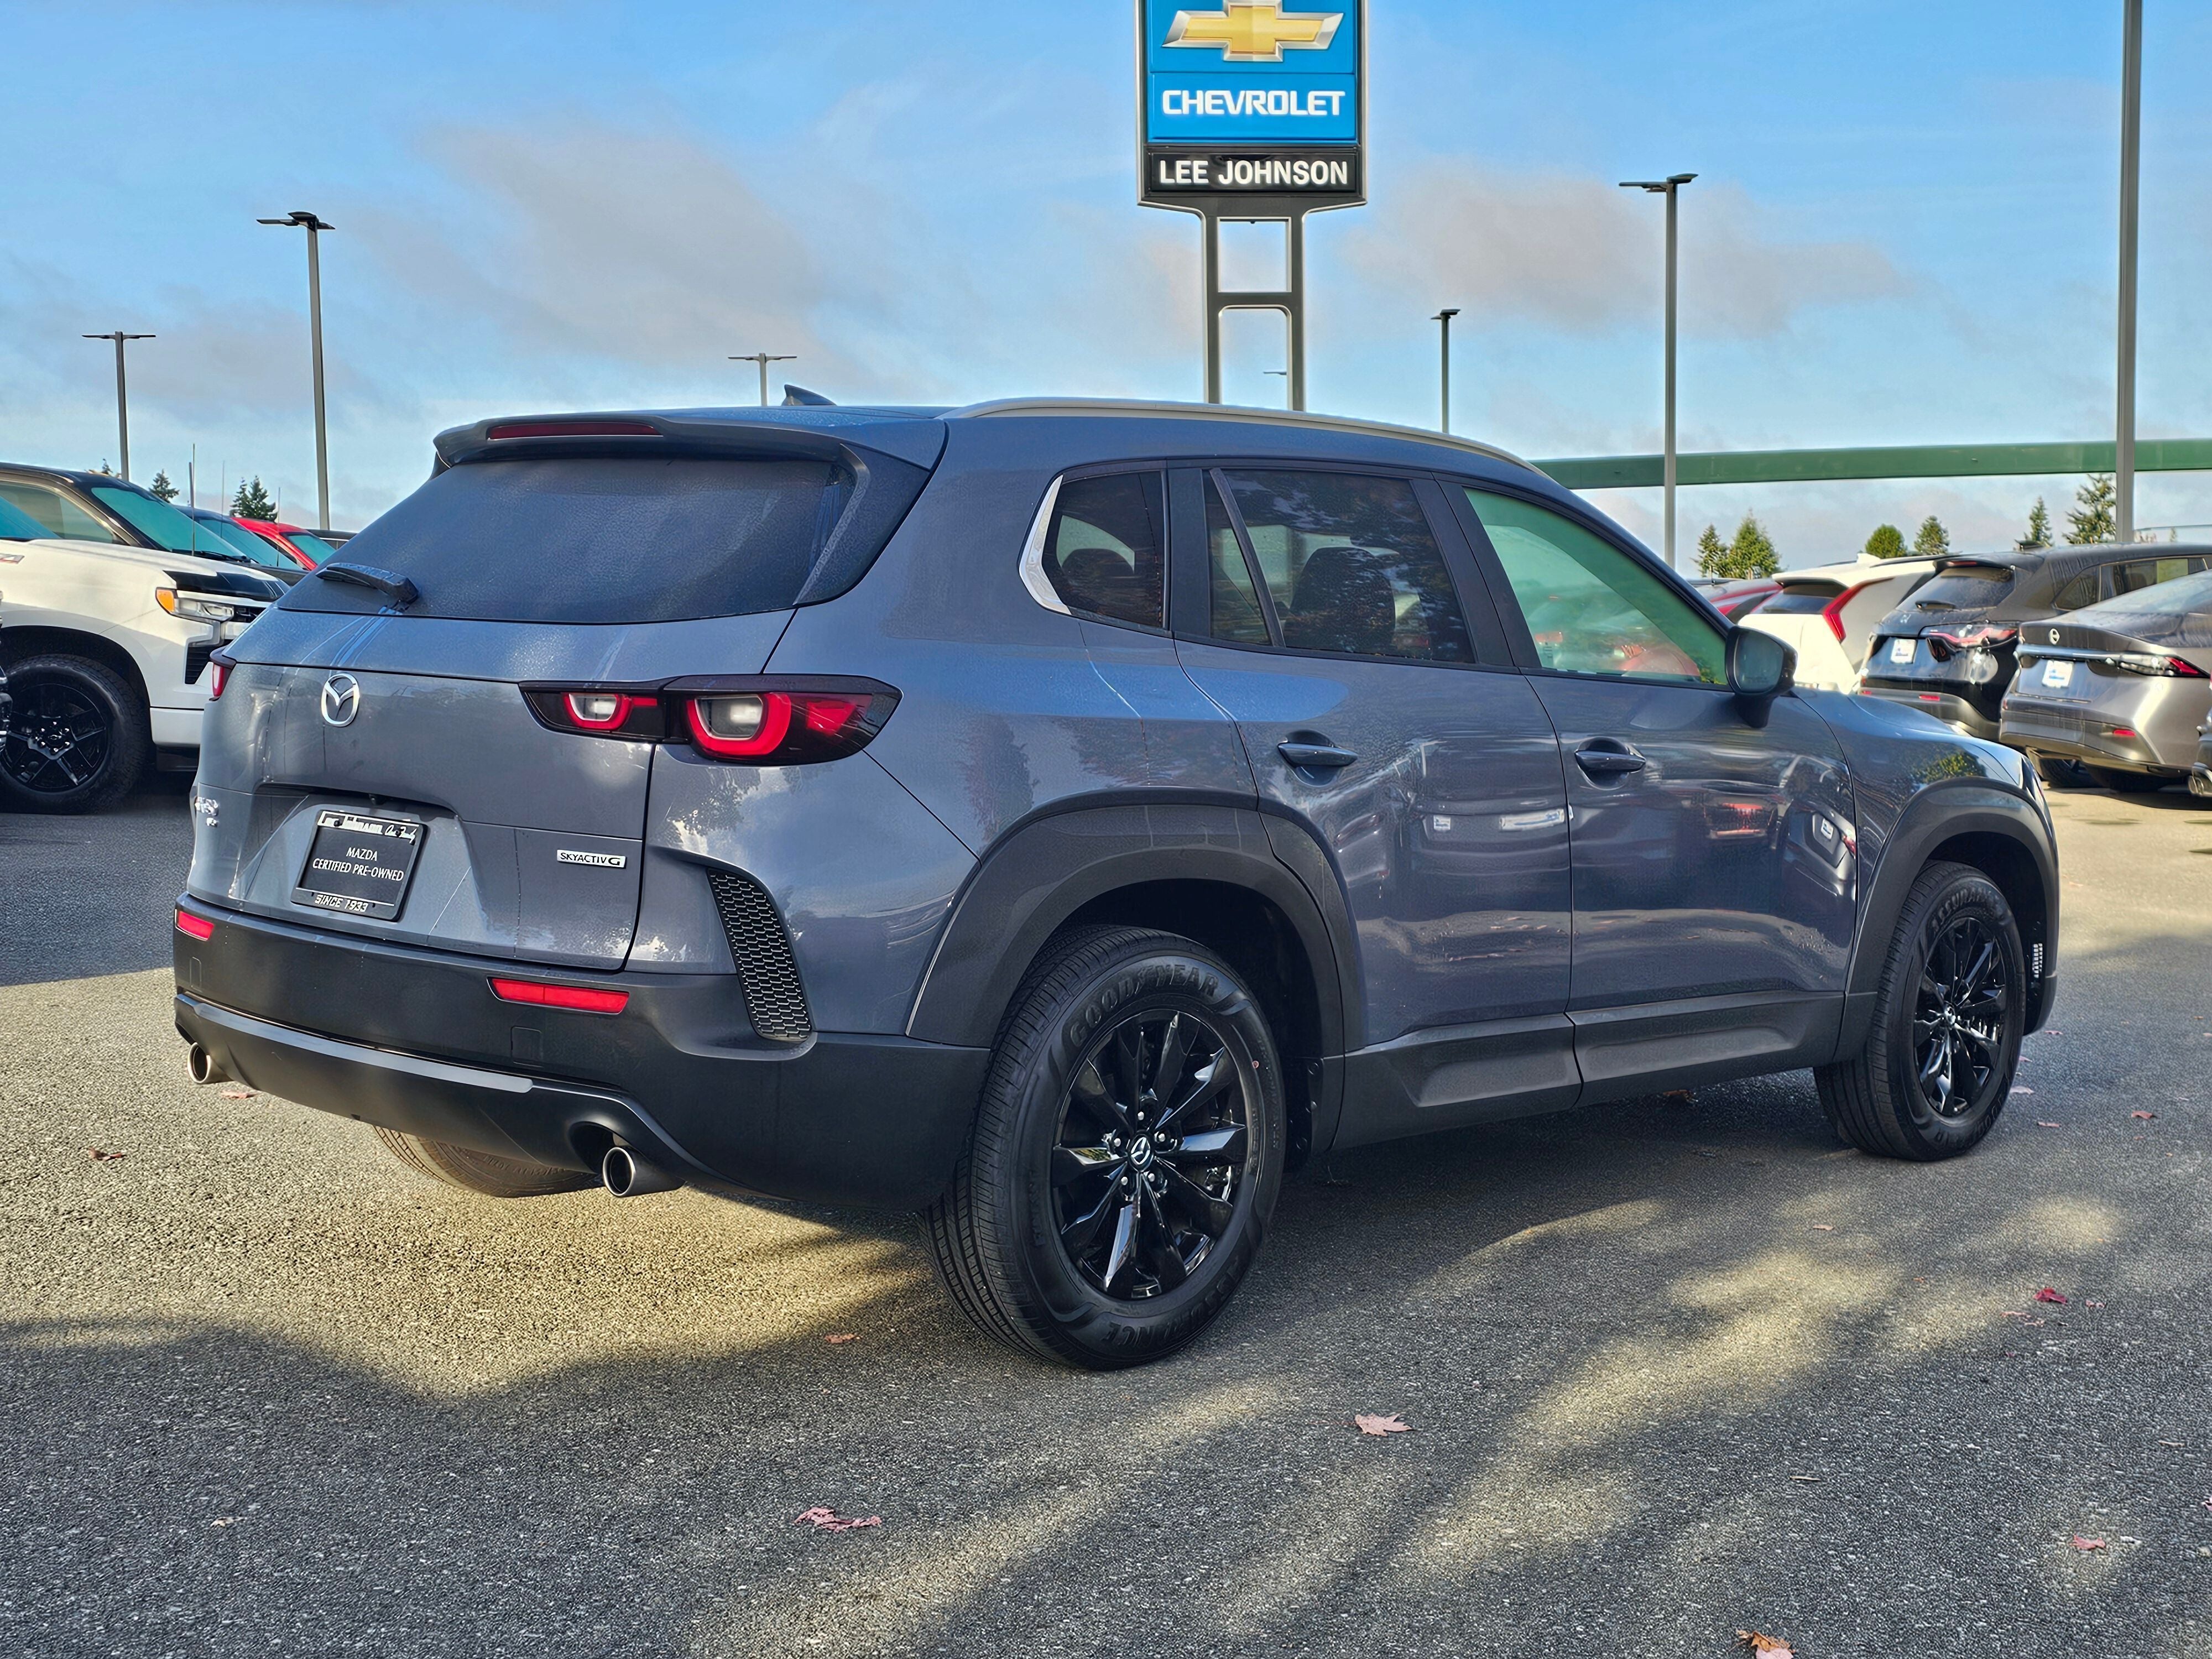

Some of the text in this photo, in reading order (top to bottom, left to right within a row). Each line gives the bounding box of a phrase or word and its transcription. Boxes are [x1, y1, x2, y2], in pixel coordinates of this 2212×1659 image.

[1162, 90, 1346, 116] CHEVROLET
[1160, 160, 1348, 185] LEE JOHNSON
[346, 847, 377, 862] MAZDA
[560, 852, 607, 864] SKYACTIV
[312, 858, 404, 881] CERTIFIED PRE-OWNED
[315, 894, 369, 912] SINCE 1933
[1070, 964, 1219, 1047] GOODYEAR
